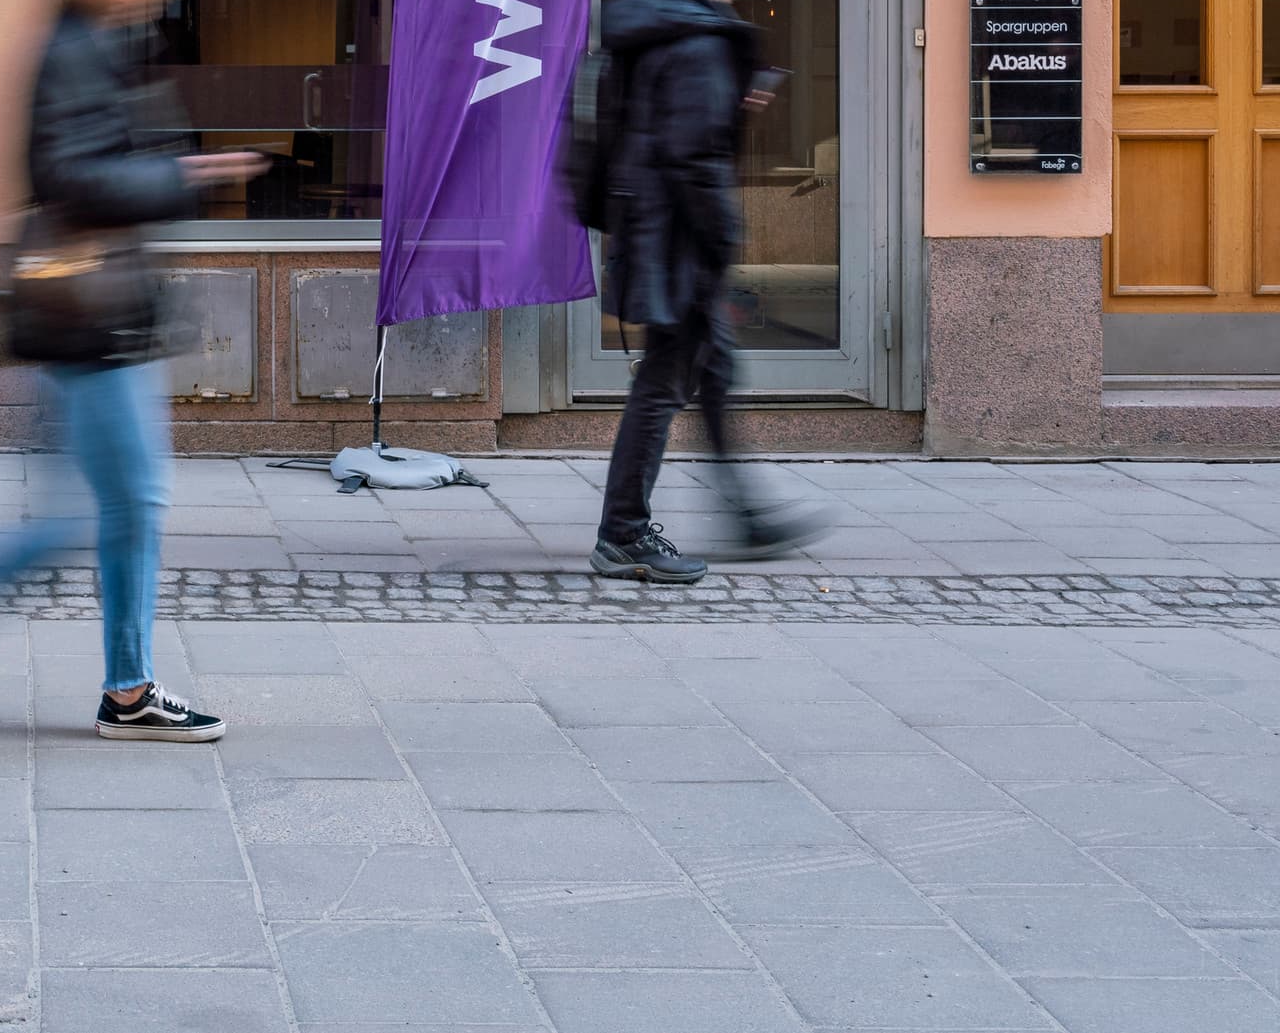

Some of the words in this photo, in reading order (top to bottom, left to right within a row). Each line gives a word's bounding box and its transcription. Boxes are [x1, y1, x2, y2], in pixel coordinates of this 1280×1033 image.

[986, 20, 1068, 35] Spargruppen
[987, 54, 1067, 70] Abakus
[1041, 160, 1065, 171] Fabege
